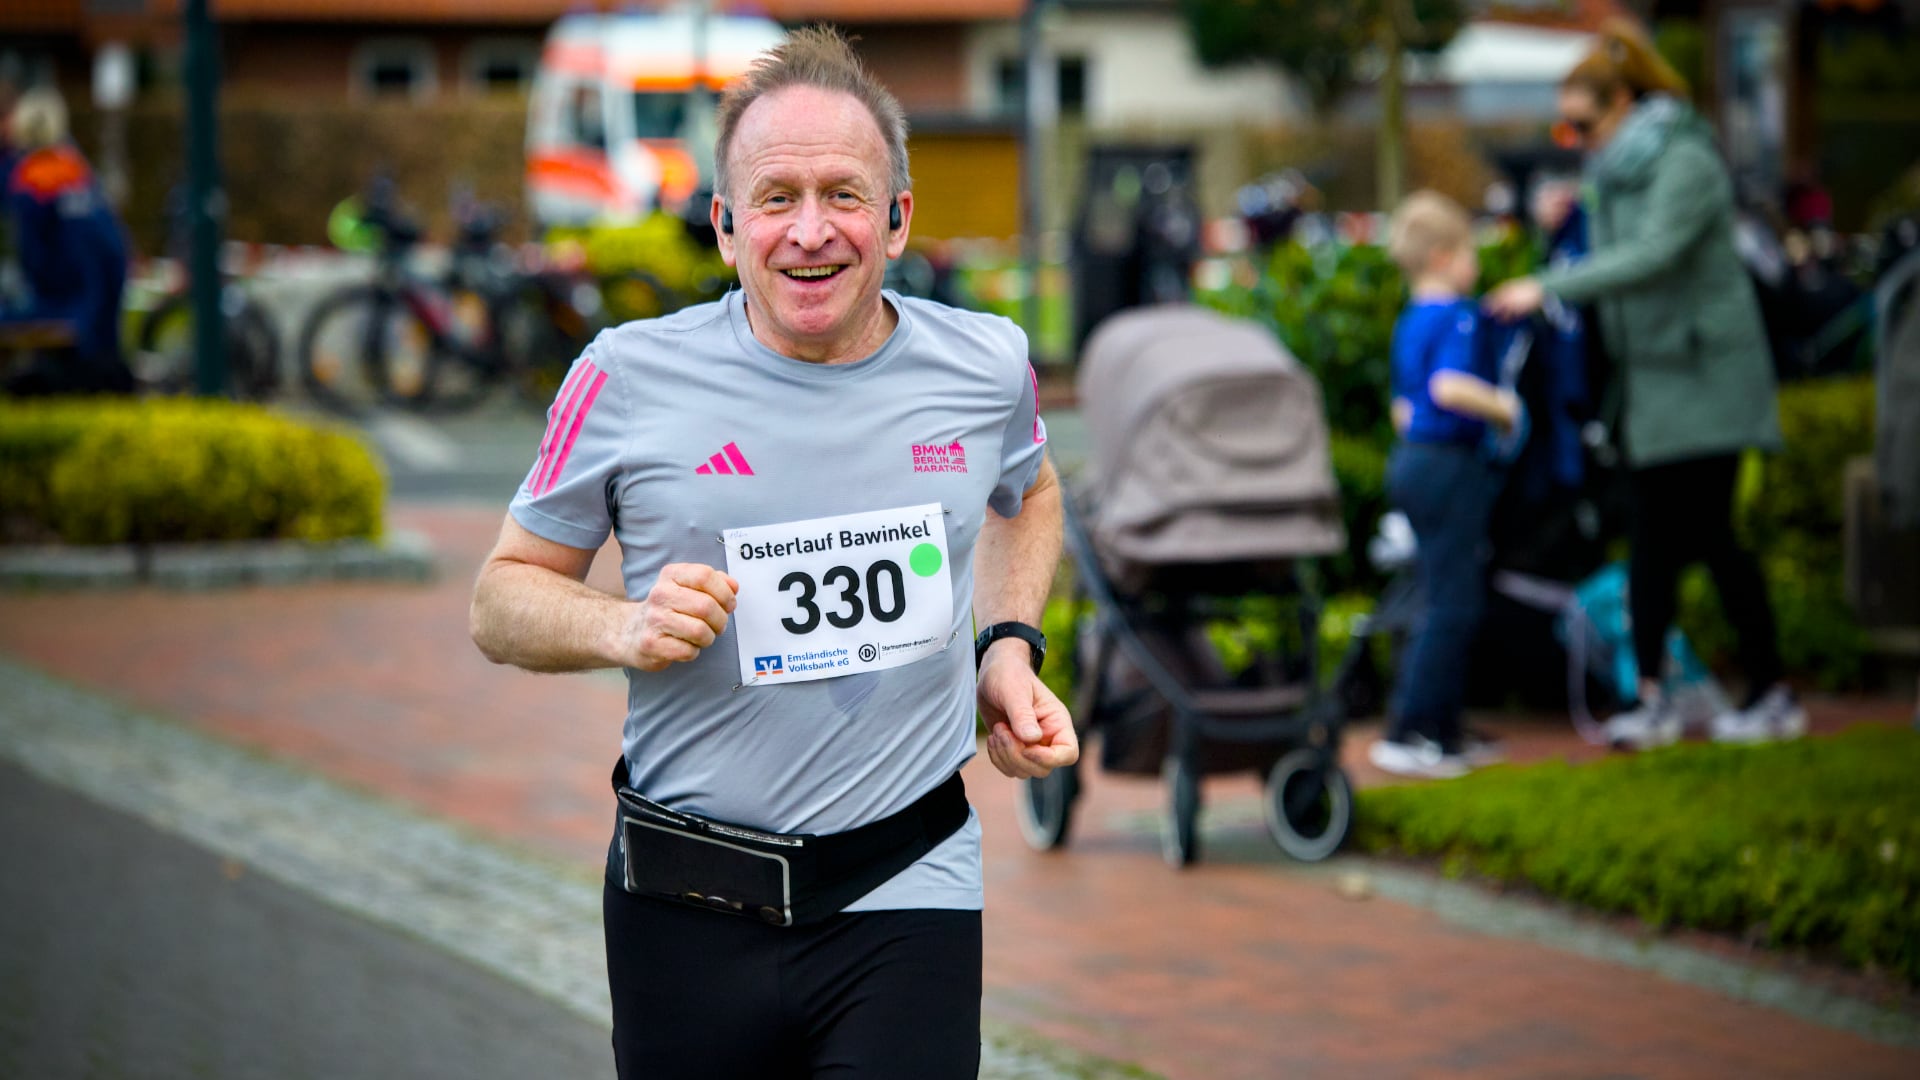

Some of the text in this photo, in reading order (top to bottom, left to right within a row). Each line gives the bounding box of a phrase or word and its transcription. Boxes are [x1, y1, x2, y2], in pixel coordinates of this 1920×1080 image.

[912, 444, 947, 456] BMW
[913, 456, 949, 465] BERLIN
[914, 465, 968, 473] MARATHON
[740, 520, 931, 560] Osterlauf Bawinkel
[778, 559, 906, 635] 330
[787, 648, 848, 662] Emsländische
[788, 658, 850, 673] Volksbank eG
